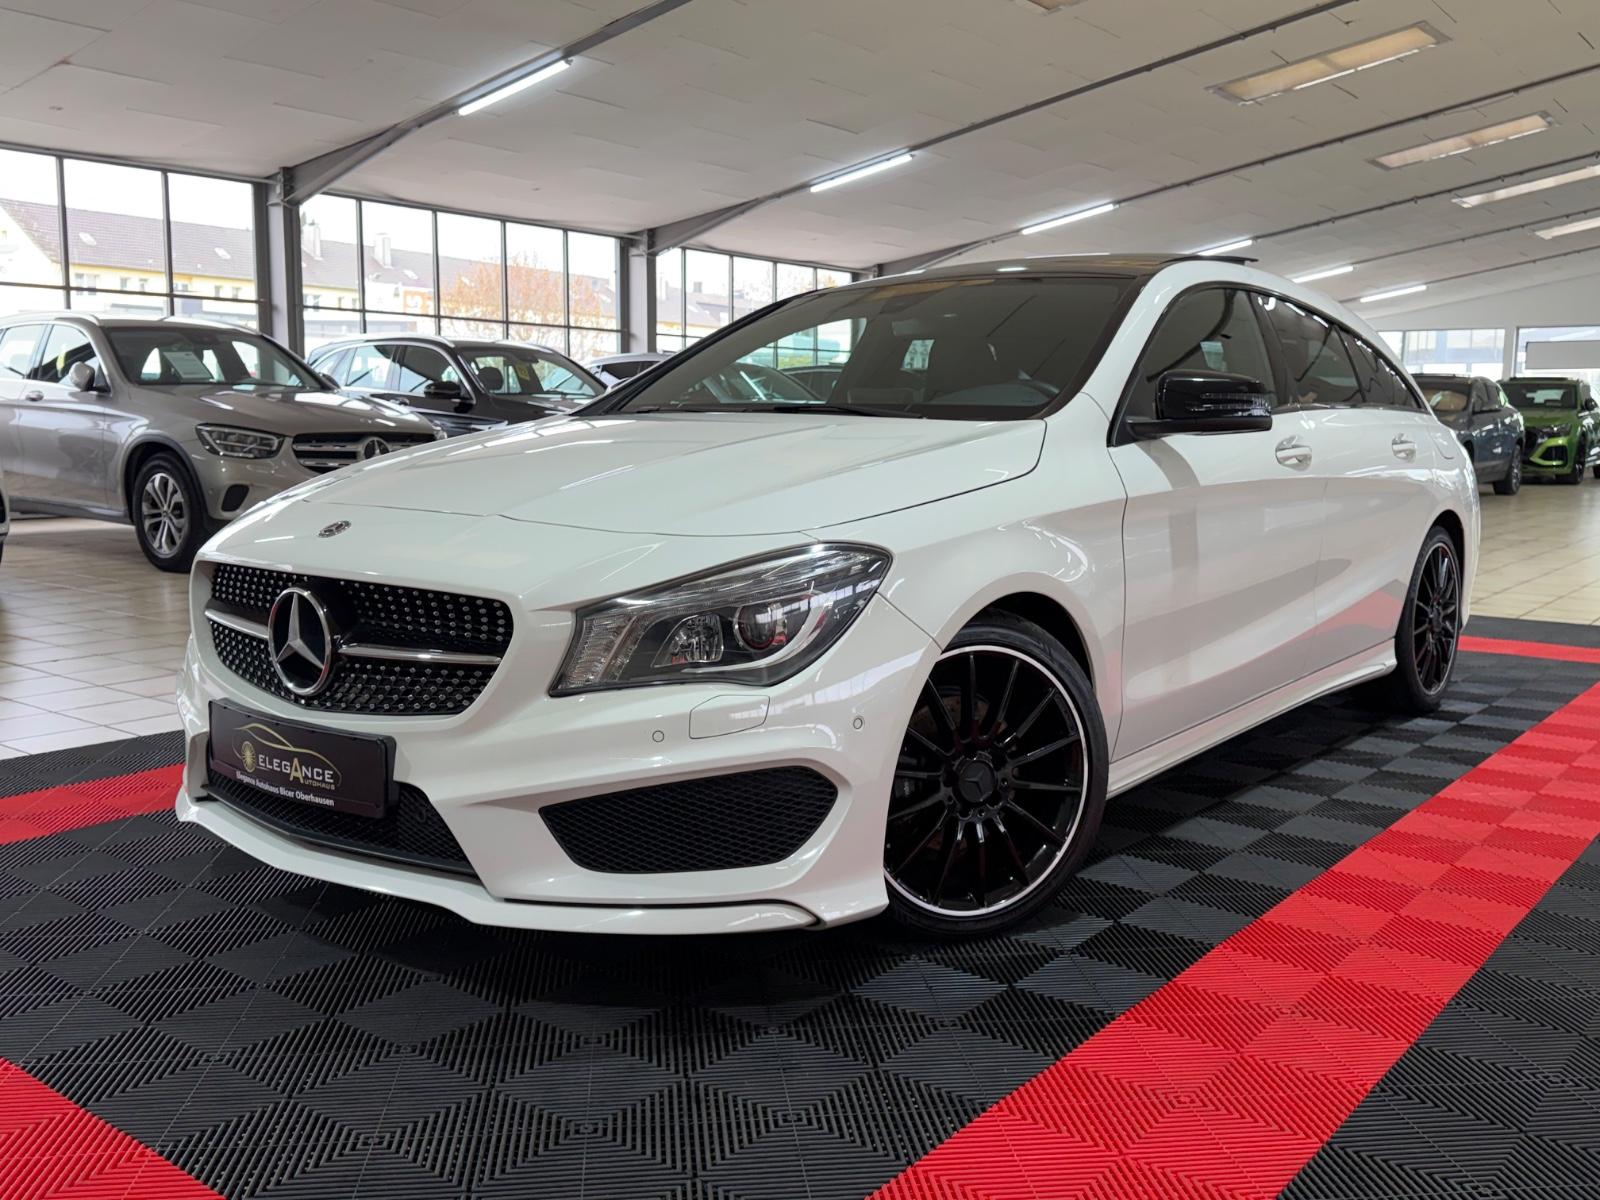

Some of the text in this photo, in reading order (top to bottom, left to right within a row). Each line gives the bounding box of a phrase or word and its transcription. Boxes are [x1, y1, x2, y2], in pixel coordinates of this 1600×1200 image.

[258, 754, 334, 783] ELEGANCE
[256, 779, 279, 794] Autohaus
[295, 790, 335, 807] Oberhausen
